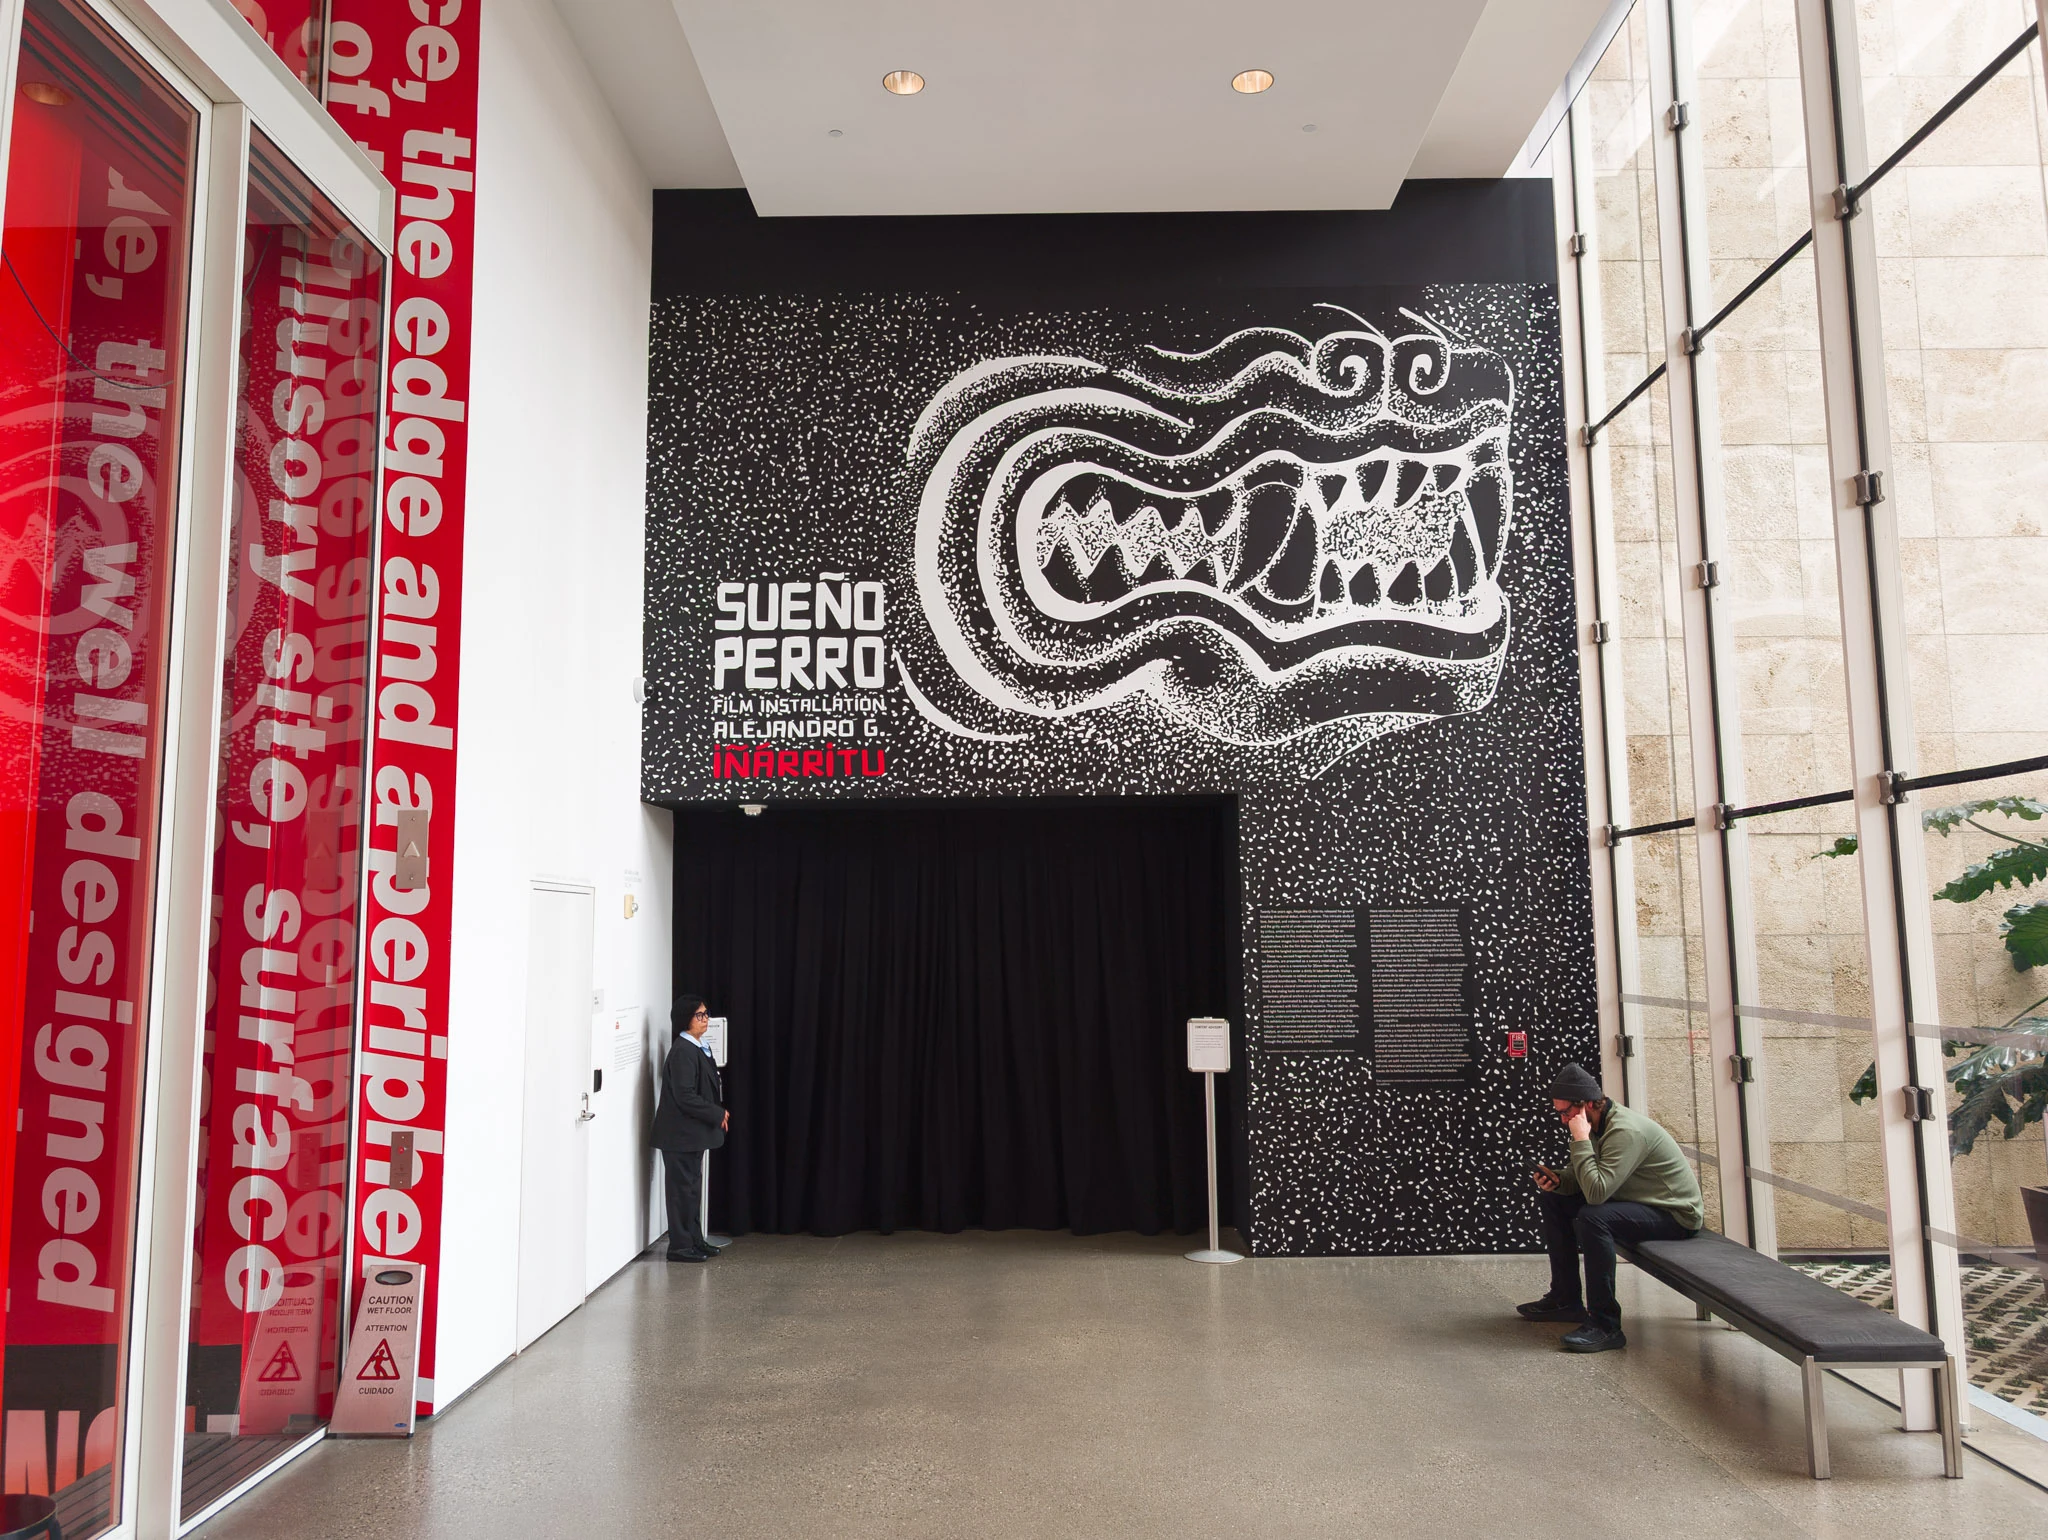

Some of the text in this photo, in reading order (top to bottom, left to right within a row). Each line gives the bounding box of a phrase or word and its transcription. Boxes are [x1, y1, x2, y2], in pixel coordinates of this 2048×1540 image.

[328, 20, 391, 118] of
[398, 127, 474, 279] the
[87, 339, 166, 503] the
[384, 297, 466, 537] edge
[714, 571, 885, 631] SUEÑO
[71, 542, 149, 759] well
[378, 557, 455, 751] and
[714, 635, 885, 691] PERRO
[231, 628, 333, 850] site,
[713, 698, 884, 714] FILM INSTALLATION
[713, 720, 854, 739] ALEJANDRO
[374, 765, 434, 827] a
[34, 791, 141, 1314] designed
[225, 883, 314, 1313] surface
[361, 848, 448, 1402] periphe
[365, 1324, 408, 1332] ATTENTION
[367, 1306, 412, 1314] WET FLOOR
[368, 1295, 414, 1305] CAUTION
[358, 1387, 394, 1395] CUIDADO
